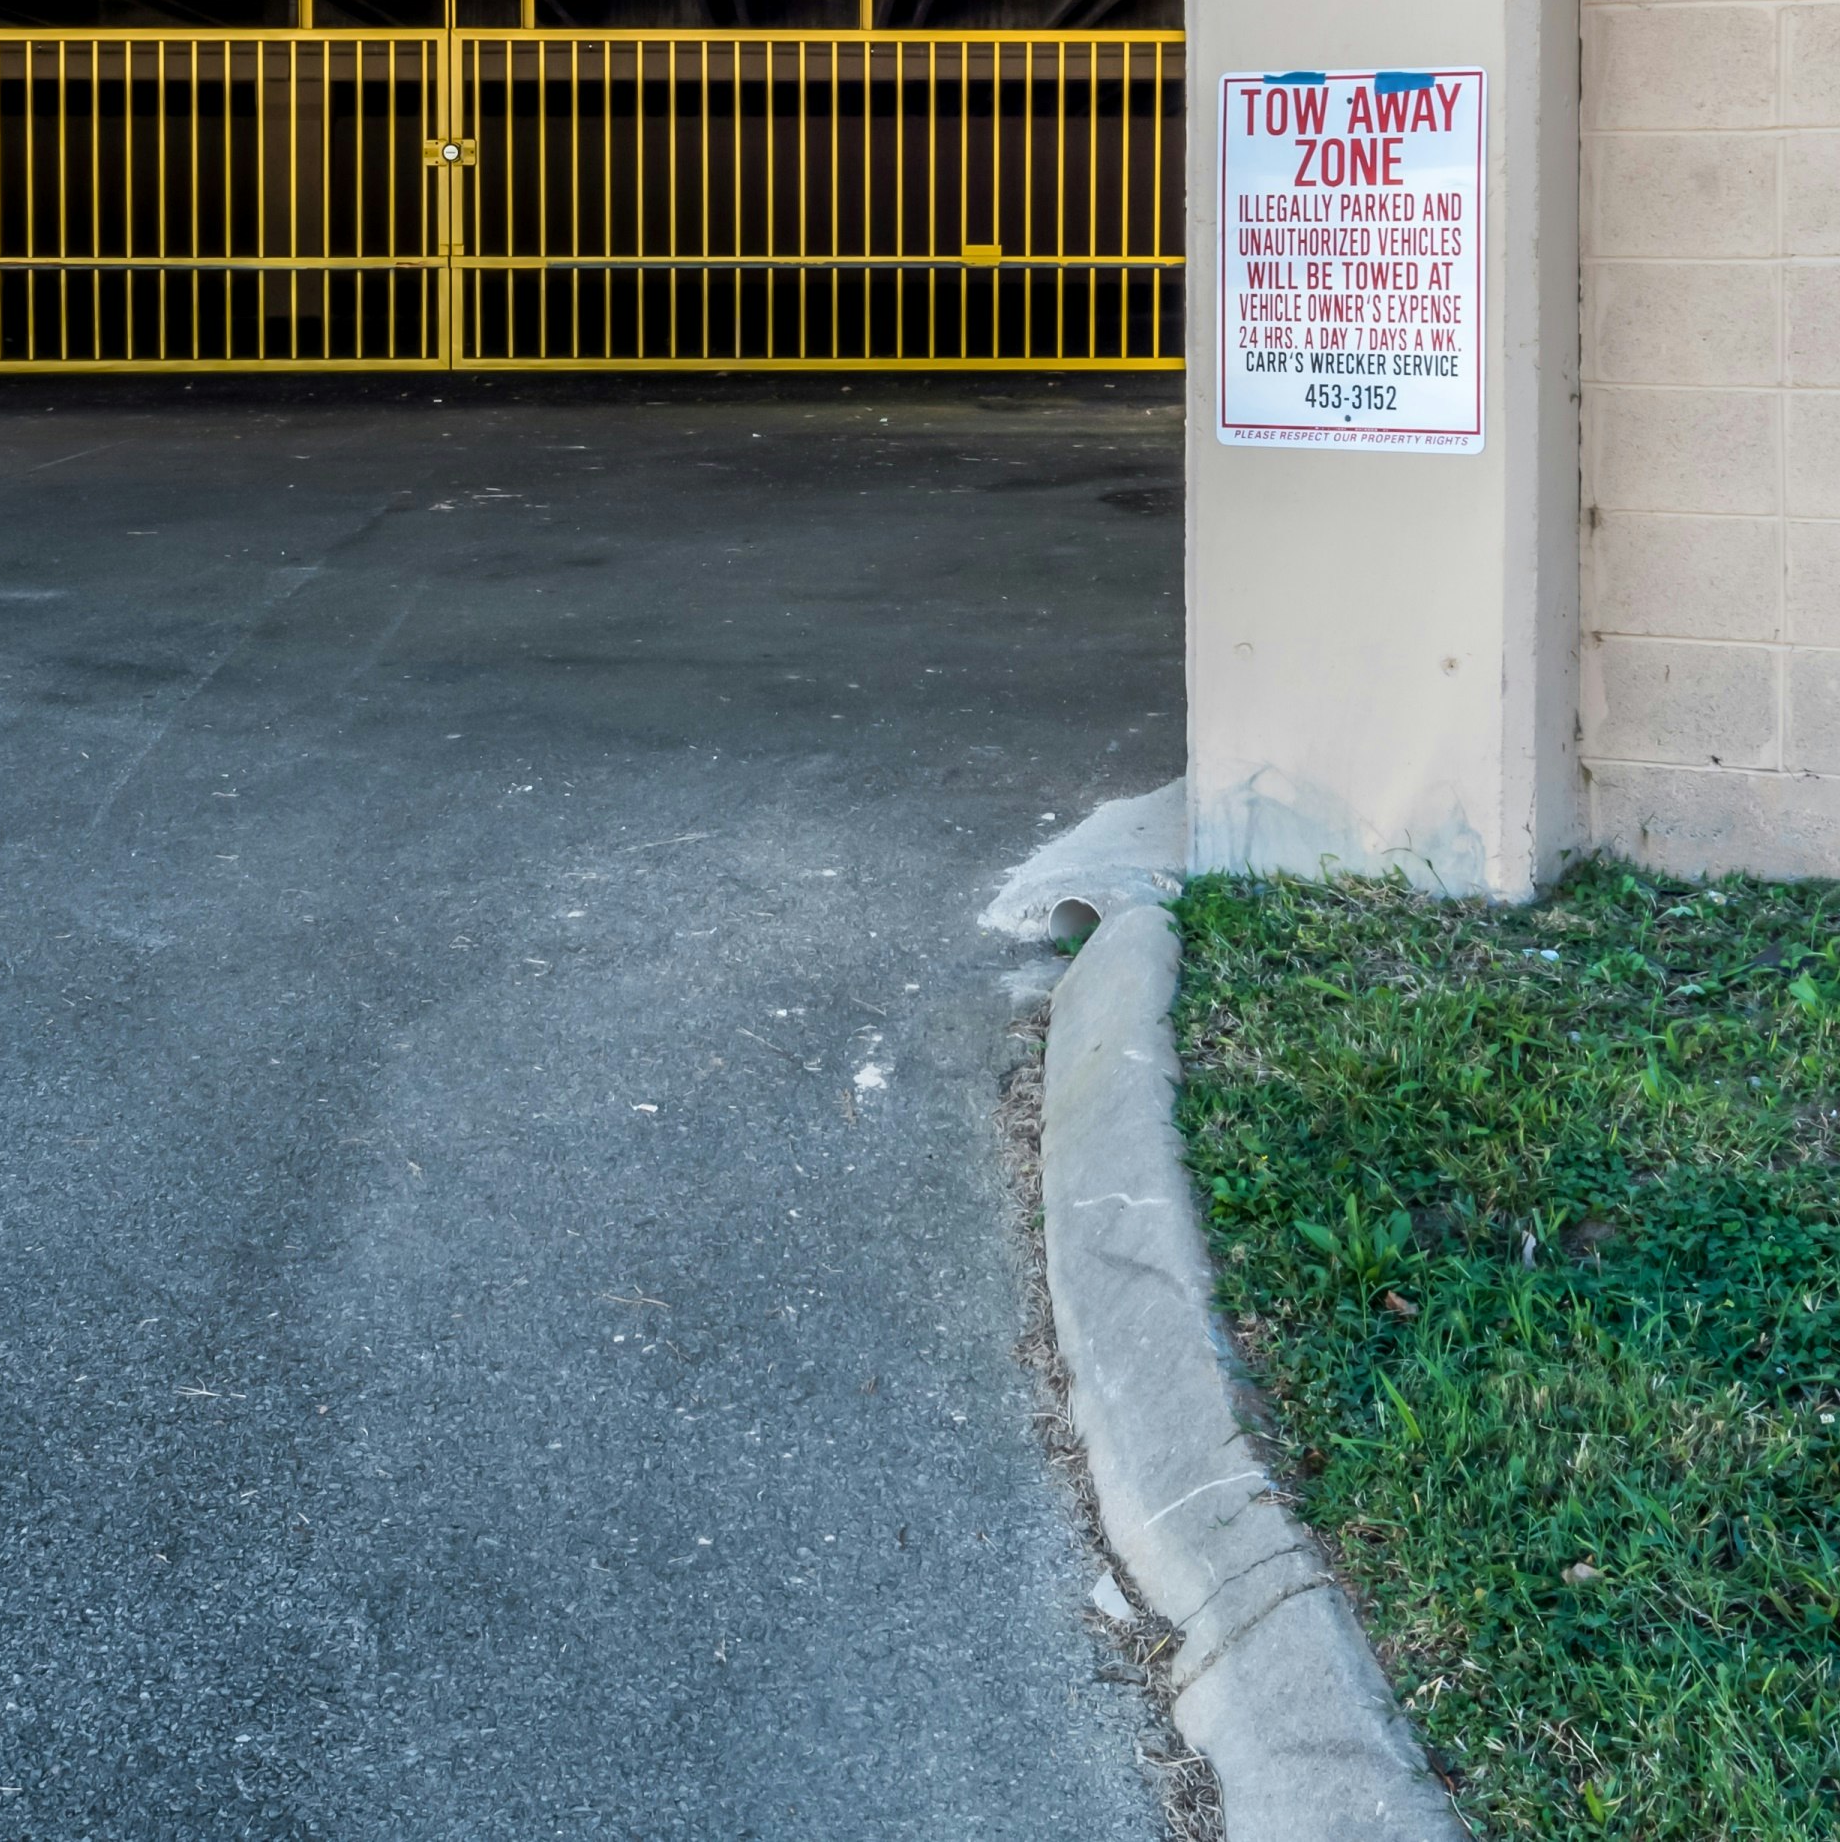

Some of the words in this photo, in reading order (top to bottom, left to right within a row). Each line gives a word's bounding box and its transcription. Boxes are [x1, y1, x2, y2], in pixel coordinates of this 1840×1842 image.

[1240, 87, 1329, 136] TOW
[1347, 83, 1462, 133] AWAY
[1294, 137, 1404, 187] ZONE
[1239, 194, 1333, 222] ILLEGALLY
[1340, 193, 1415, 222] PARKED
[1422, 193, 1462, 221] AND
[1239, 227, 1371, 256] UNAUTHORIZED
[1378, 227, 1462, 256] VEHICLES
[1247, 262, 1298, 290] WILL
[1307, 262, 1333, 290] BE
[1342, 262, 1418, 290] TOWED
[1428, 262, 1454, 291] AT
[1239, 293, 1302, 322] VEHICLE
[1307, 294, 1381, 323] OWNER'S
[1387, 295, 1462, 324] EXPENSE
[1239, 326, 1259, 348] 24
[1264, 327, 1298, 349] HRS.
[1304, 327, 1314, 349] A
[1320, 327, 1348, 350] DAY
[1354, 328, 1363, 350] 7
[1369, 328, 1408, 351] DAYS
[1414, 329, 1424, 351] A
[1431, 329, 1462, 352] WK.
[1246, 351, 1304, 373] CARR'S
[1310, 353, 1388, 375] WRECKER
[1393, 355, 1459, 377] SERVICE
[1305, 384, 1397, 411] 453-3152
[1234, 429, 1277, 440] PLEASE
[1279, 431, 1330, 441] RESPECT
[1333, 433, 1357, 442] OUR
[1360, 433, 1422, 444] PROPERTY
[1424, 435, 1469, 446] RIGHTS
